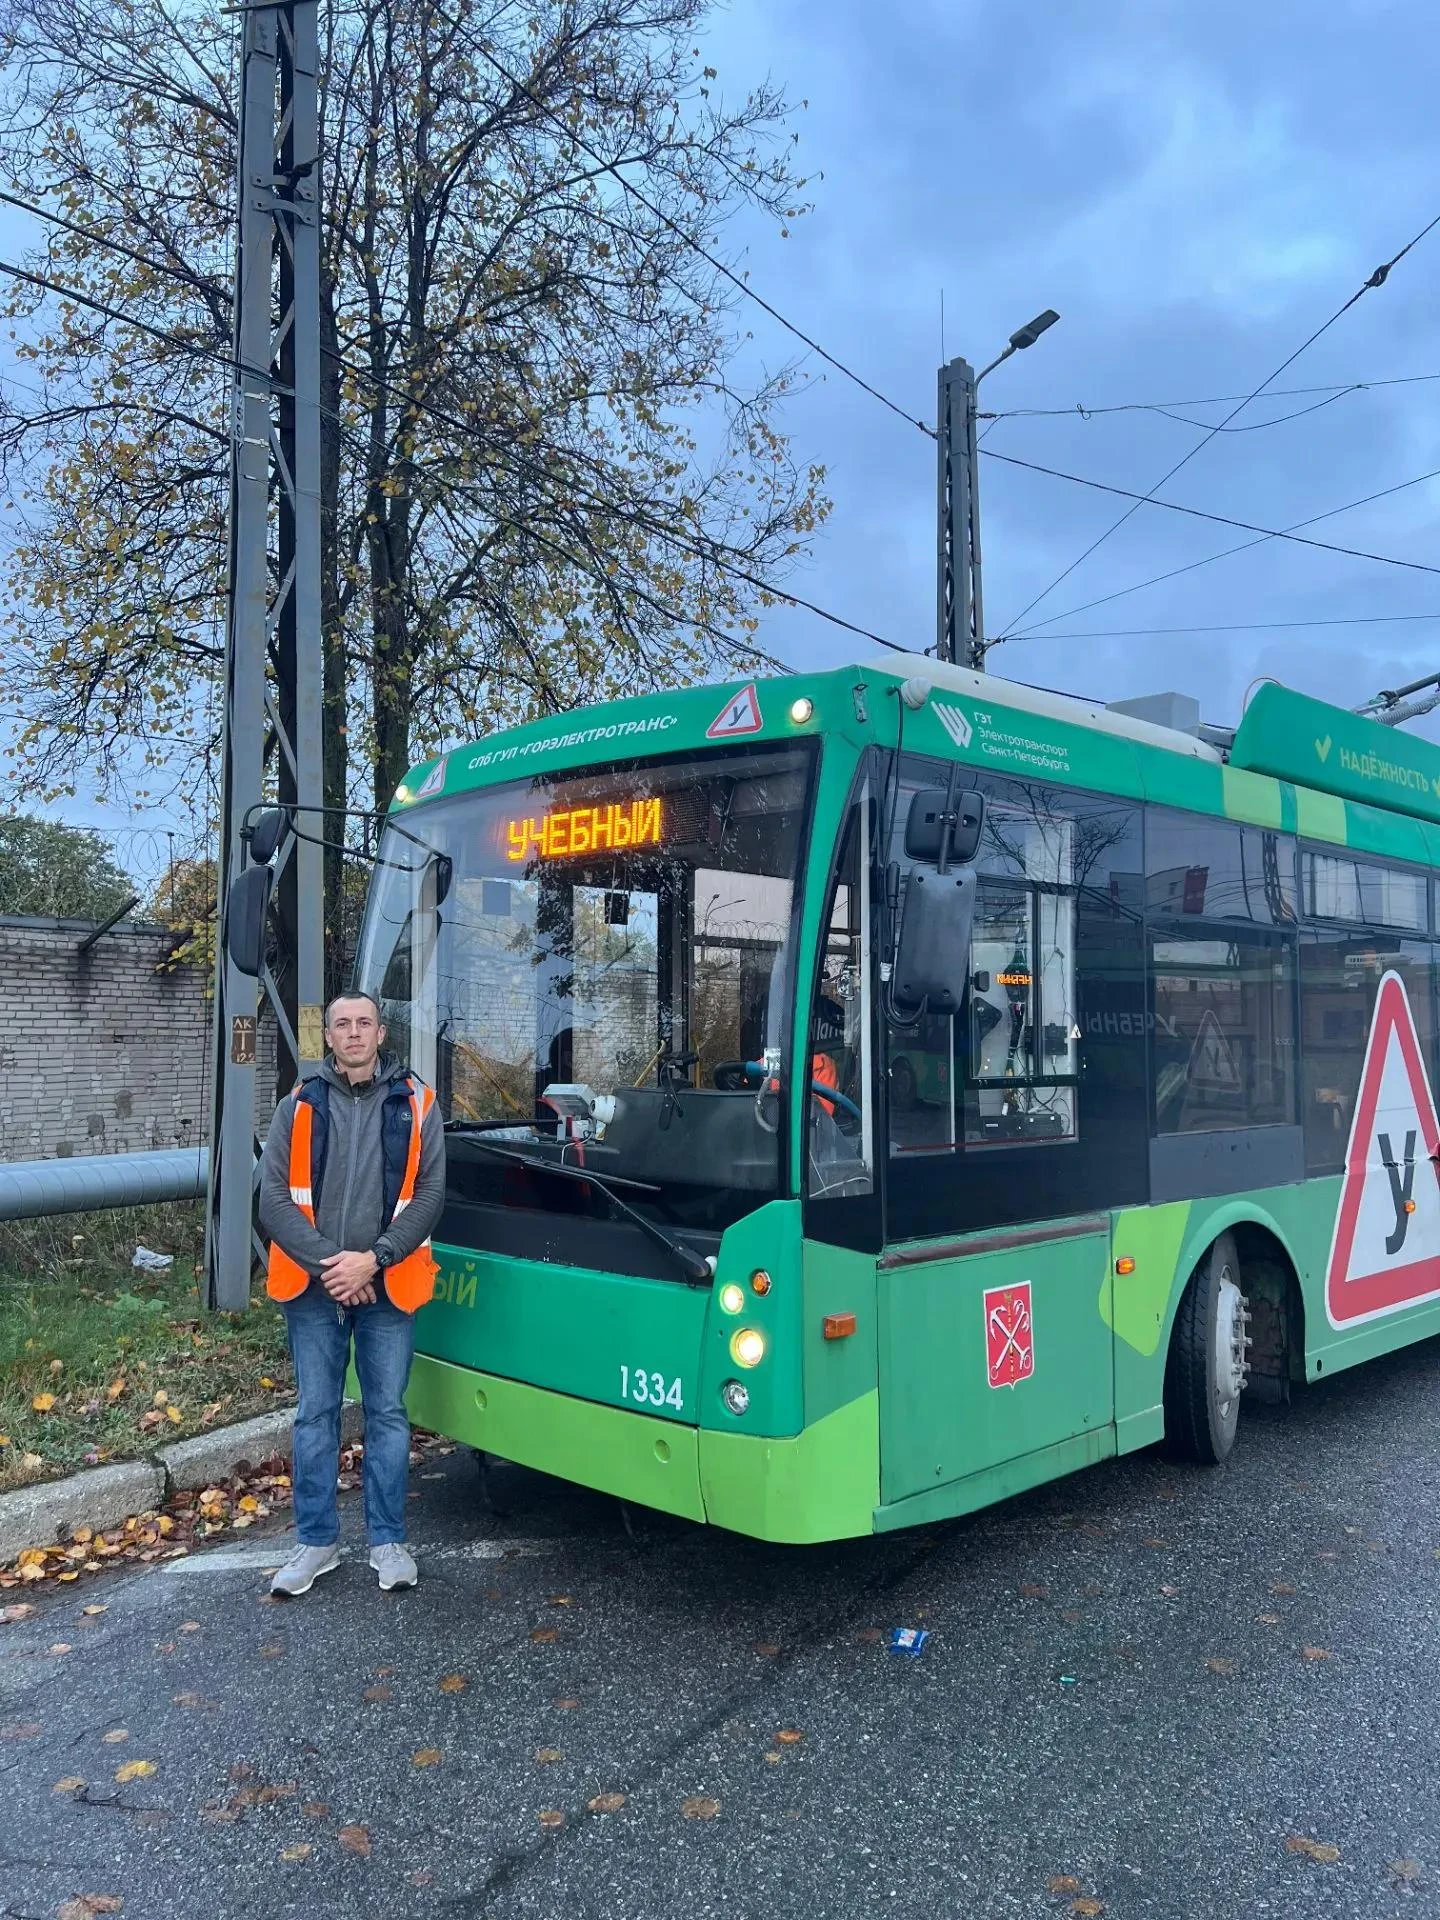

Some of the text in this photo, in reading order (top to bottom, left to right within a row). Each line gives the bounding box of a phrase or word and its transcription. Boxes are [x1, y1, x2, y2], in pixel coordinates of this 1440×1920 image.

[728, 704, 748, 727] У
[973, 711, 992, 726] ГЭТ
[491, 746, 519, 765] ГУП
[519, 714, 679, 757] «ГОРЭЛЕКТРОТРАНС»
[977, 725, 1069, 757] Электротранспорт
[981, 741, 1071, 772] Санкт-Петербурга
[1339, 746, 1430, 793] НАДЁЖНОСТЬ
[506, 797, 662, 863] УЧЕБНЫЙ
[1377, 1130, 1417, 1255] У
[619, 1365, 684, 1411] 1334
